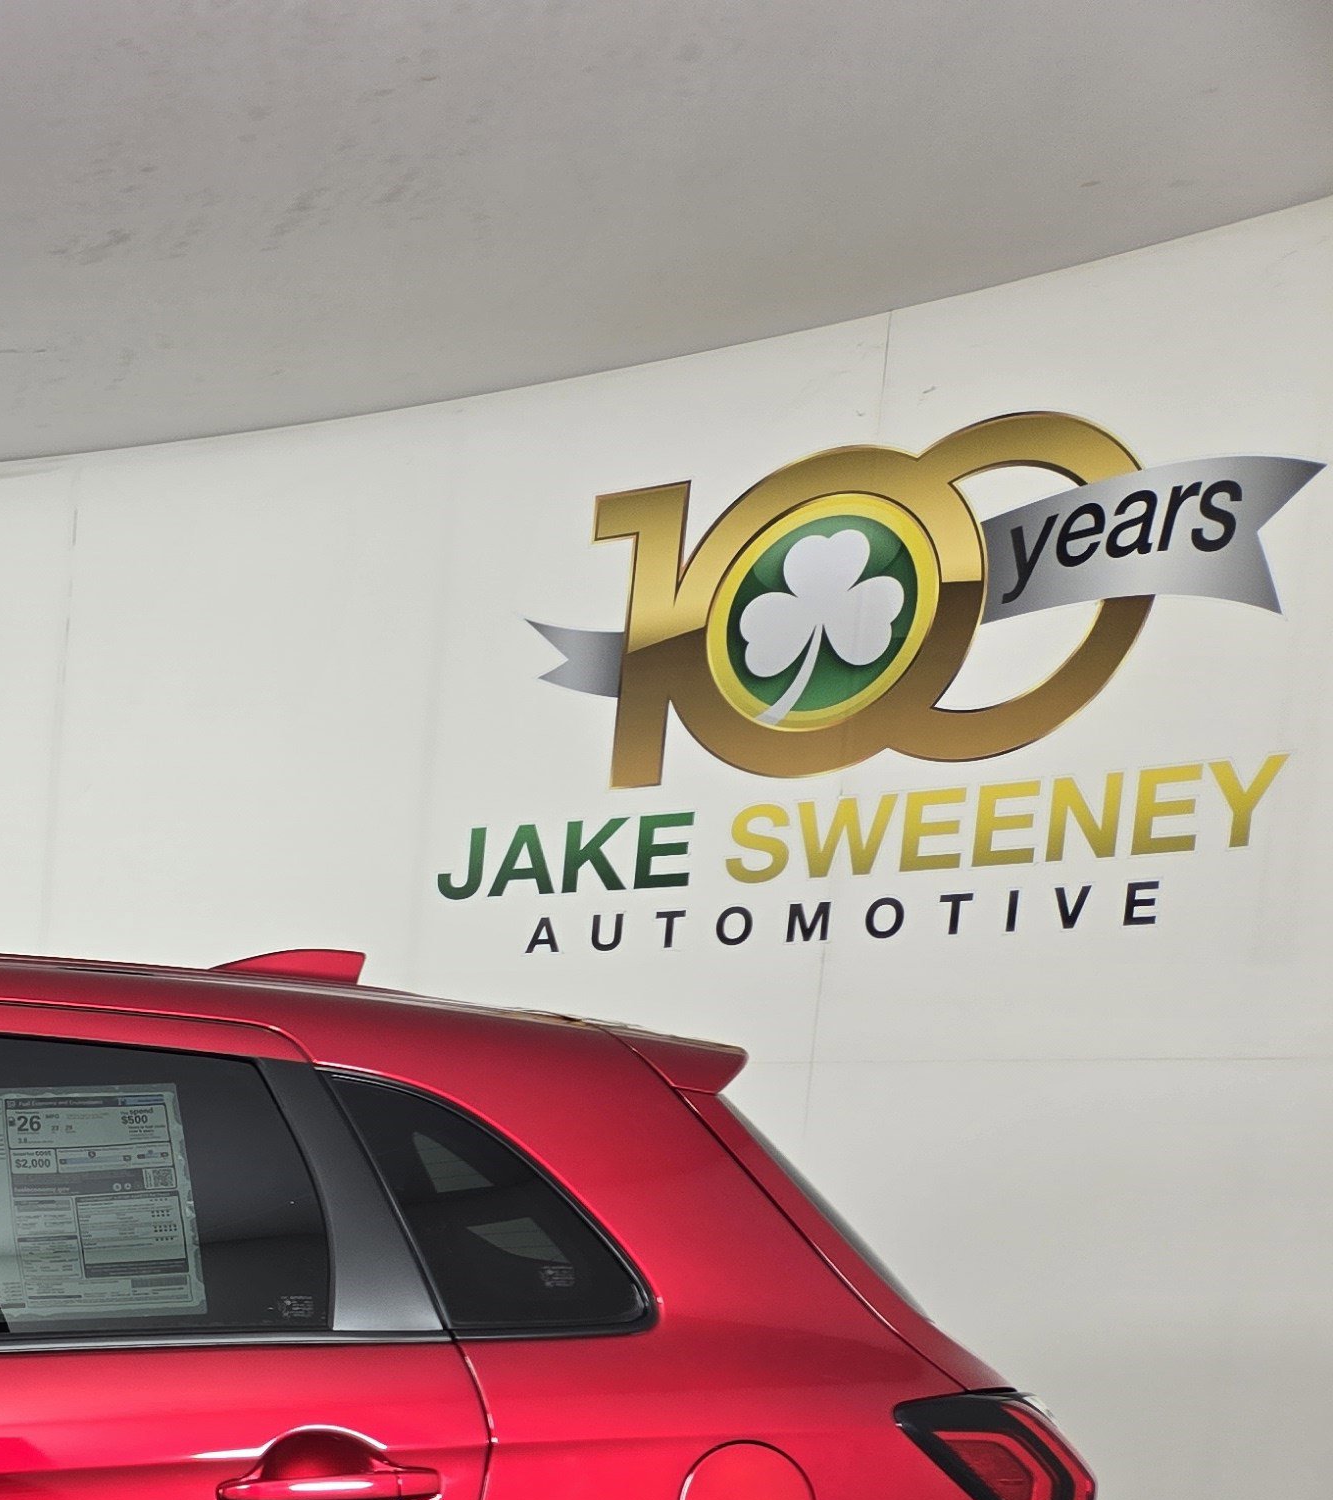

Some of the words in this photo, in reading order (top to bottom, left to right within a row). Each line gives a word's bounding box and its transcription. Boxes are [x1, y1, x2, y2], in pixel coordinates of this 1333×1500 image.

[1001, 479, 1244, 603] years
[593, 411, 1156, 788] 100
[437, 811, 695, 900] JAKE
[726, 753, 1291, 884] SWEENEY
[525, 881, 1162, 955] AUTOMOTIVE
[16, 1114, 41, 1132] 26
[121, 1114, 147, 1124] $500
[14, 1158, 51, 1169] $2,000
